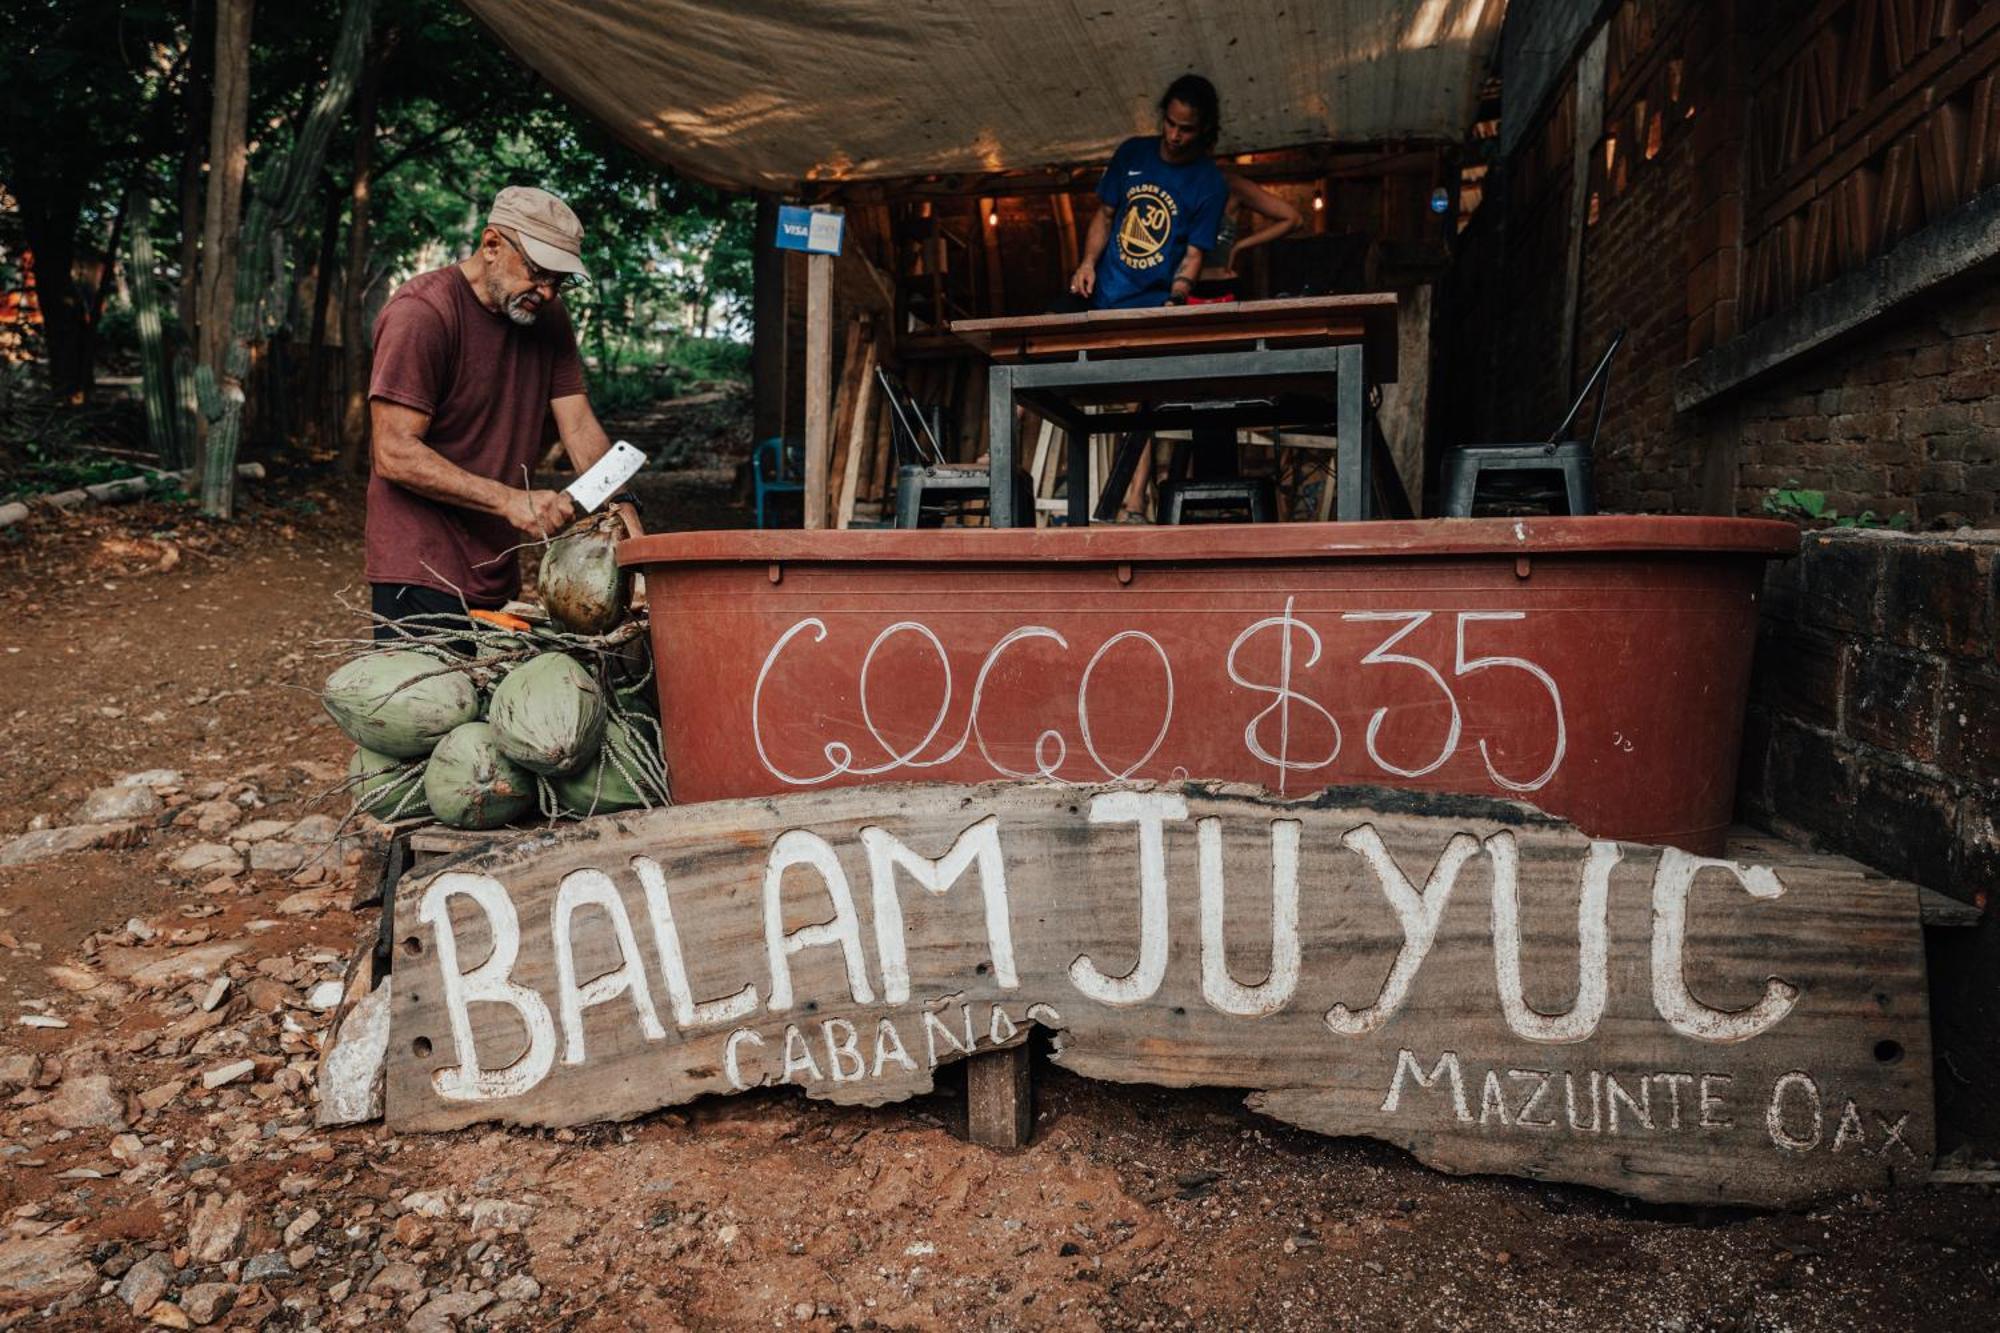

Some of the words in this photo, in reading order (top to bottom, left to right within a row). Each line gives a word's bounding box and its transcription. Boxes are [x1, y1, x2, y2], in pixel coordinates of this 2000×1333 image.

[783, 223, 809, 237] VISA
[1141, 204, 1166, 231] 30
[752, 616, 1176, 784] COCO
[1227, 594, 1567, 795] $35
[419, 813, 1020, 1101] BALAM
[1066, 791, 1800, 1045] JUYUC
[1379, 1046, 1734, 1134] MAZUNTE
